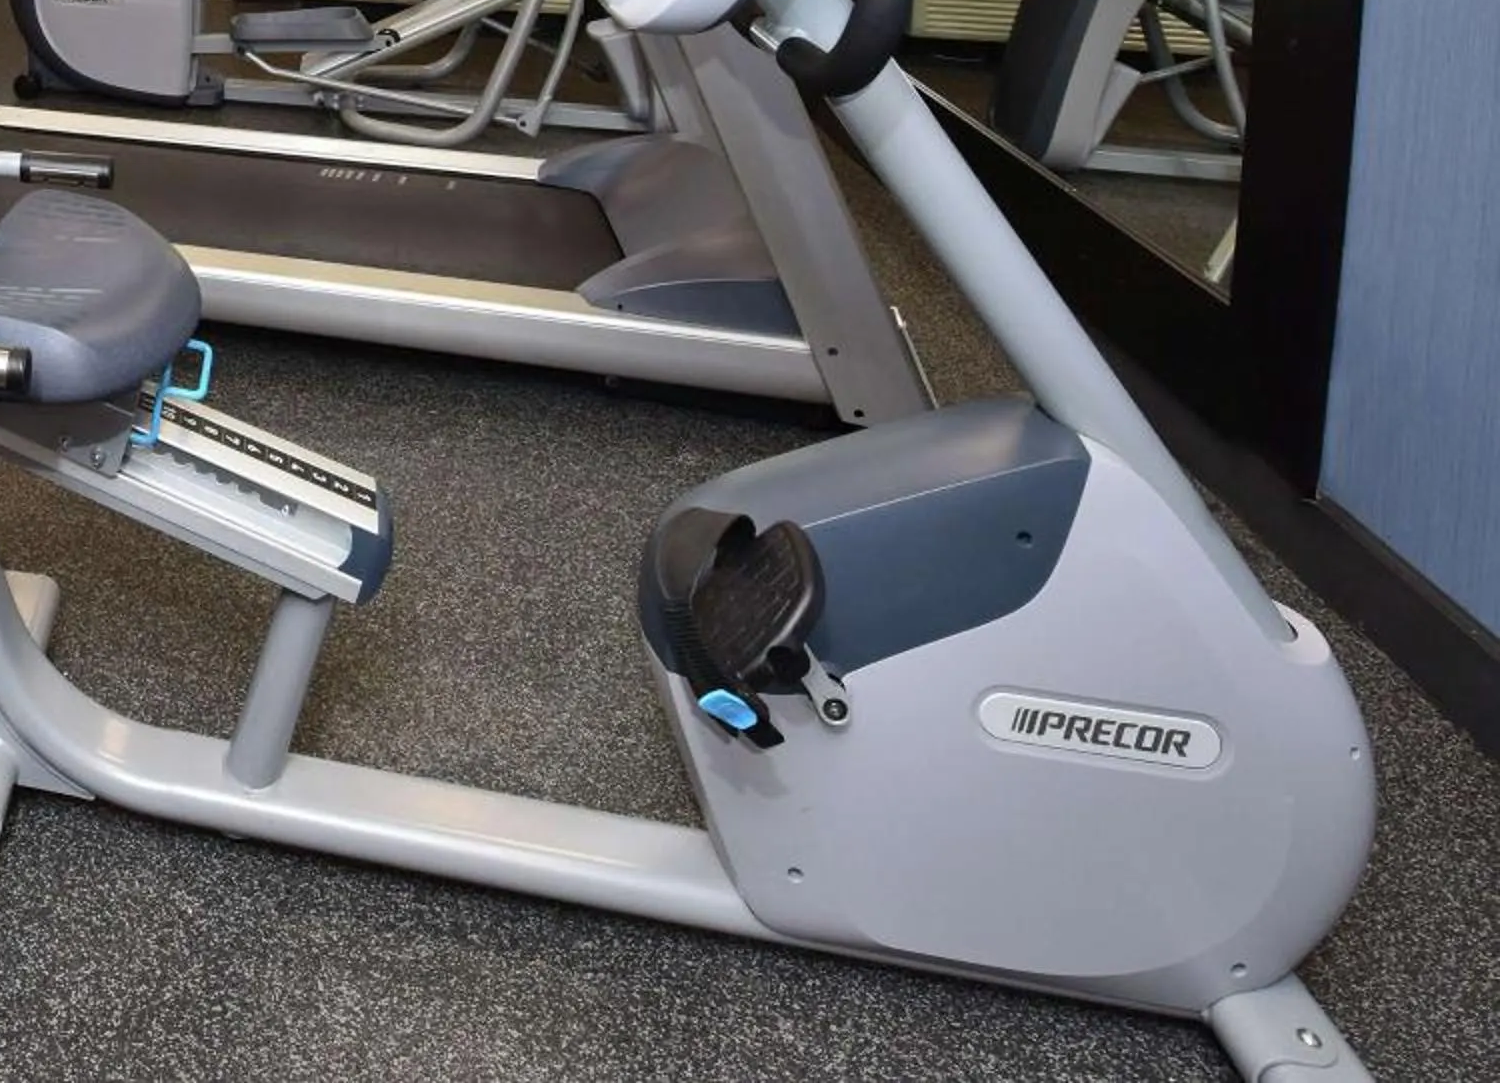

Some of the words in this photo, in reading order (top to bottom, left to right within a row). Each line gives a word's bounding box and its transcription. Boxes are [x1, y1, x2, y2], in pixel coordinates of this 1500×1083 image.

[268, 453, 284, 464] 5
[312, 472, 328, 483] 3
[333, 481, 350, 492] 2
[1035, 710, 1191, 758] PRECOR
